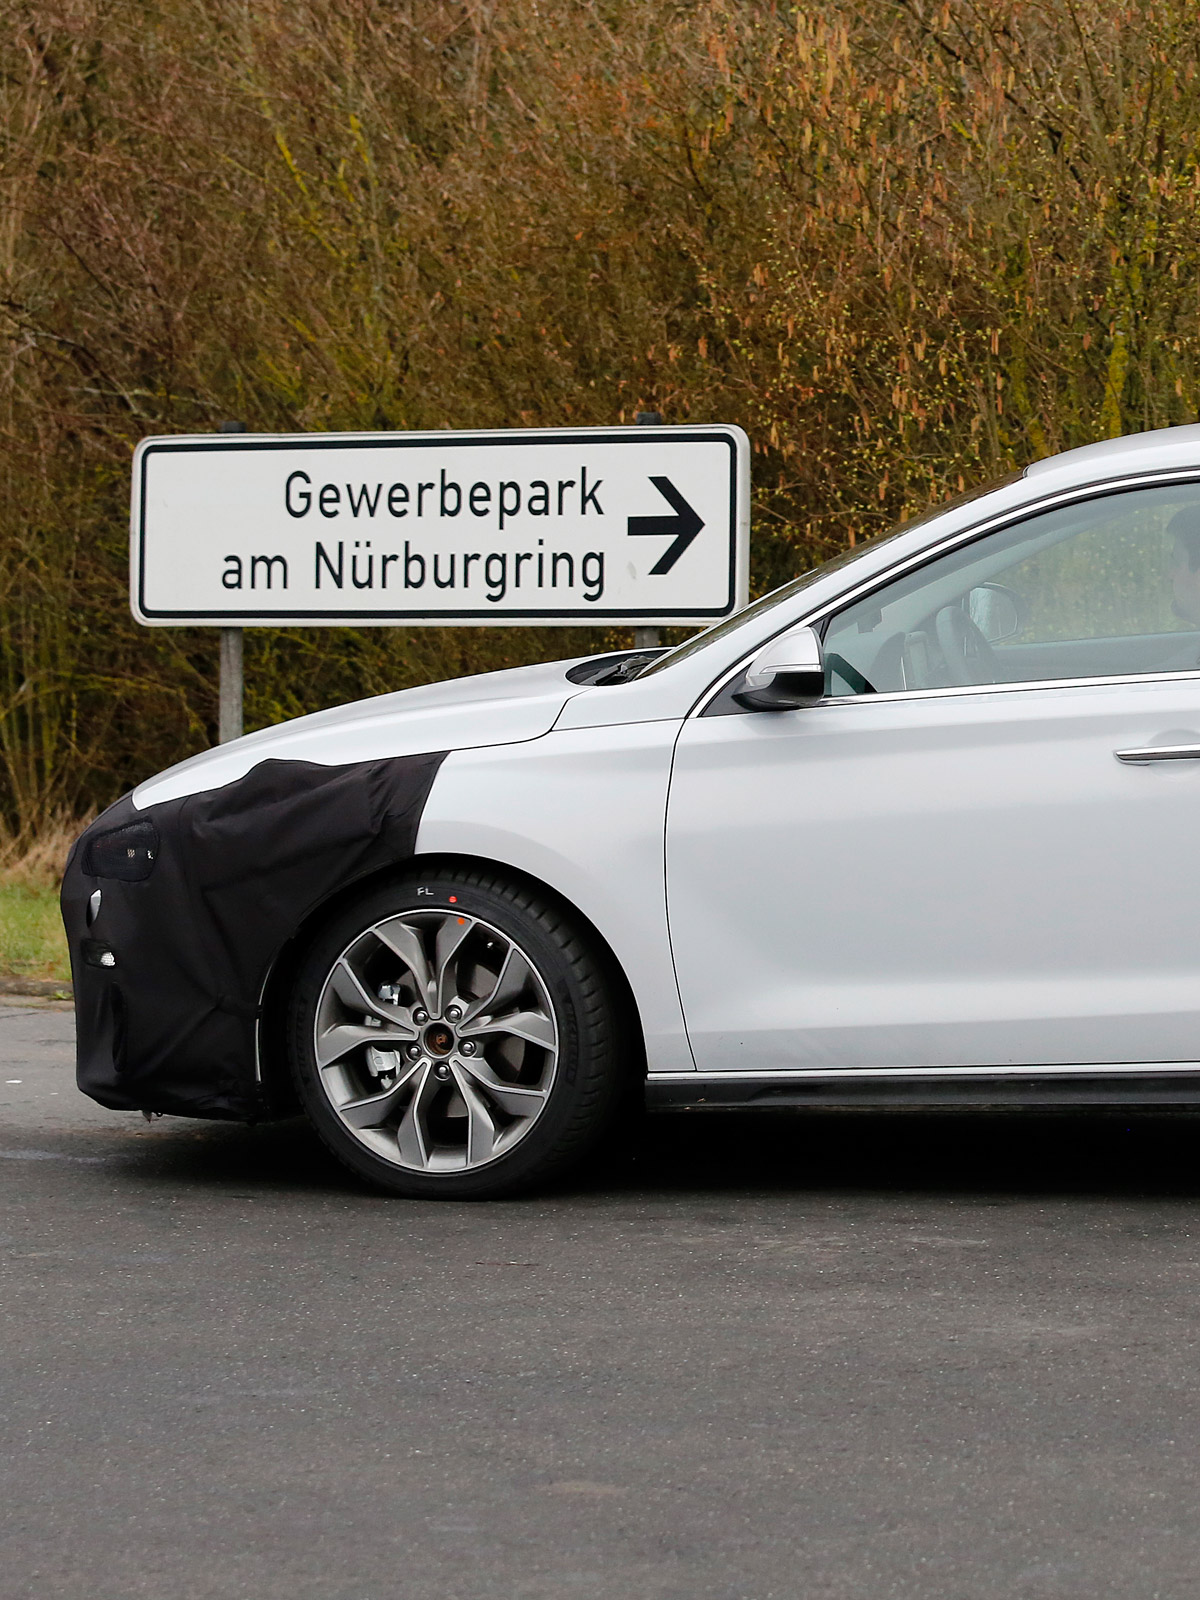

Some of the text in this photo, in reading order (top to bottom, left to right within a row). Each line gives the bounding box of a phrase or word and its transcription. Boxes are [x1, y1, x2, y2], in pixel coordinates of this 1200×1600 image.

[285, 466, 605, 530] Gewerbepark
[221, 539, 605, 602] am Nürburgring
[416, 886, 435, 896] FL
